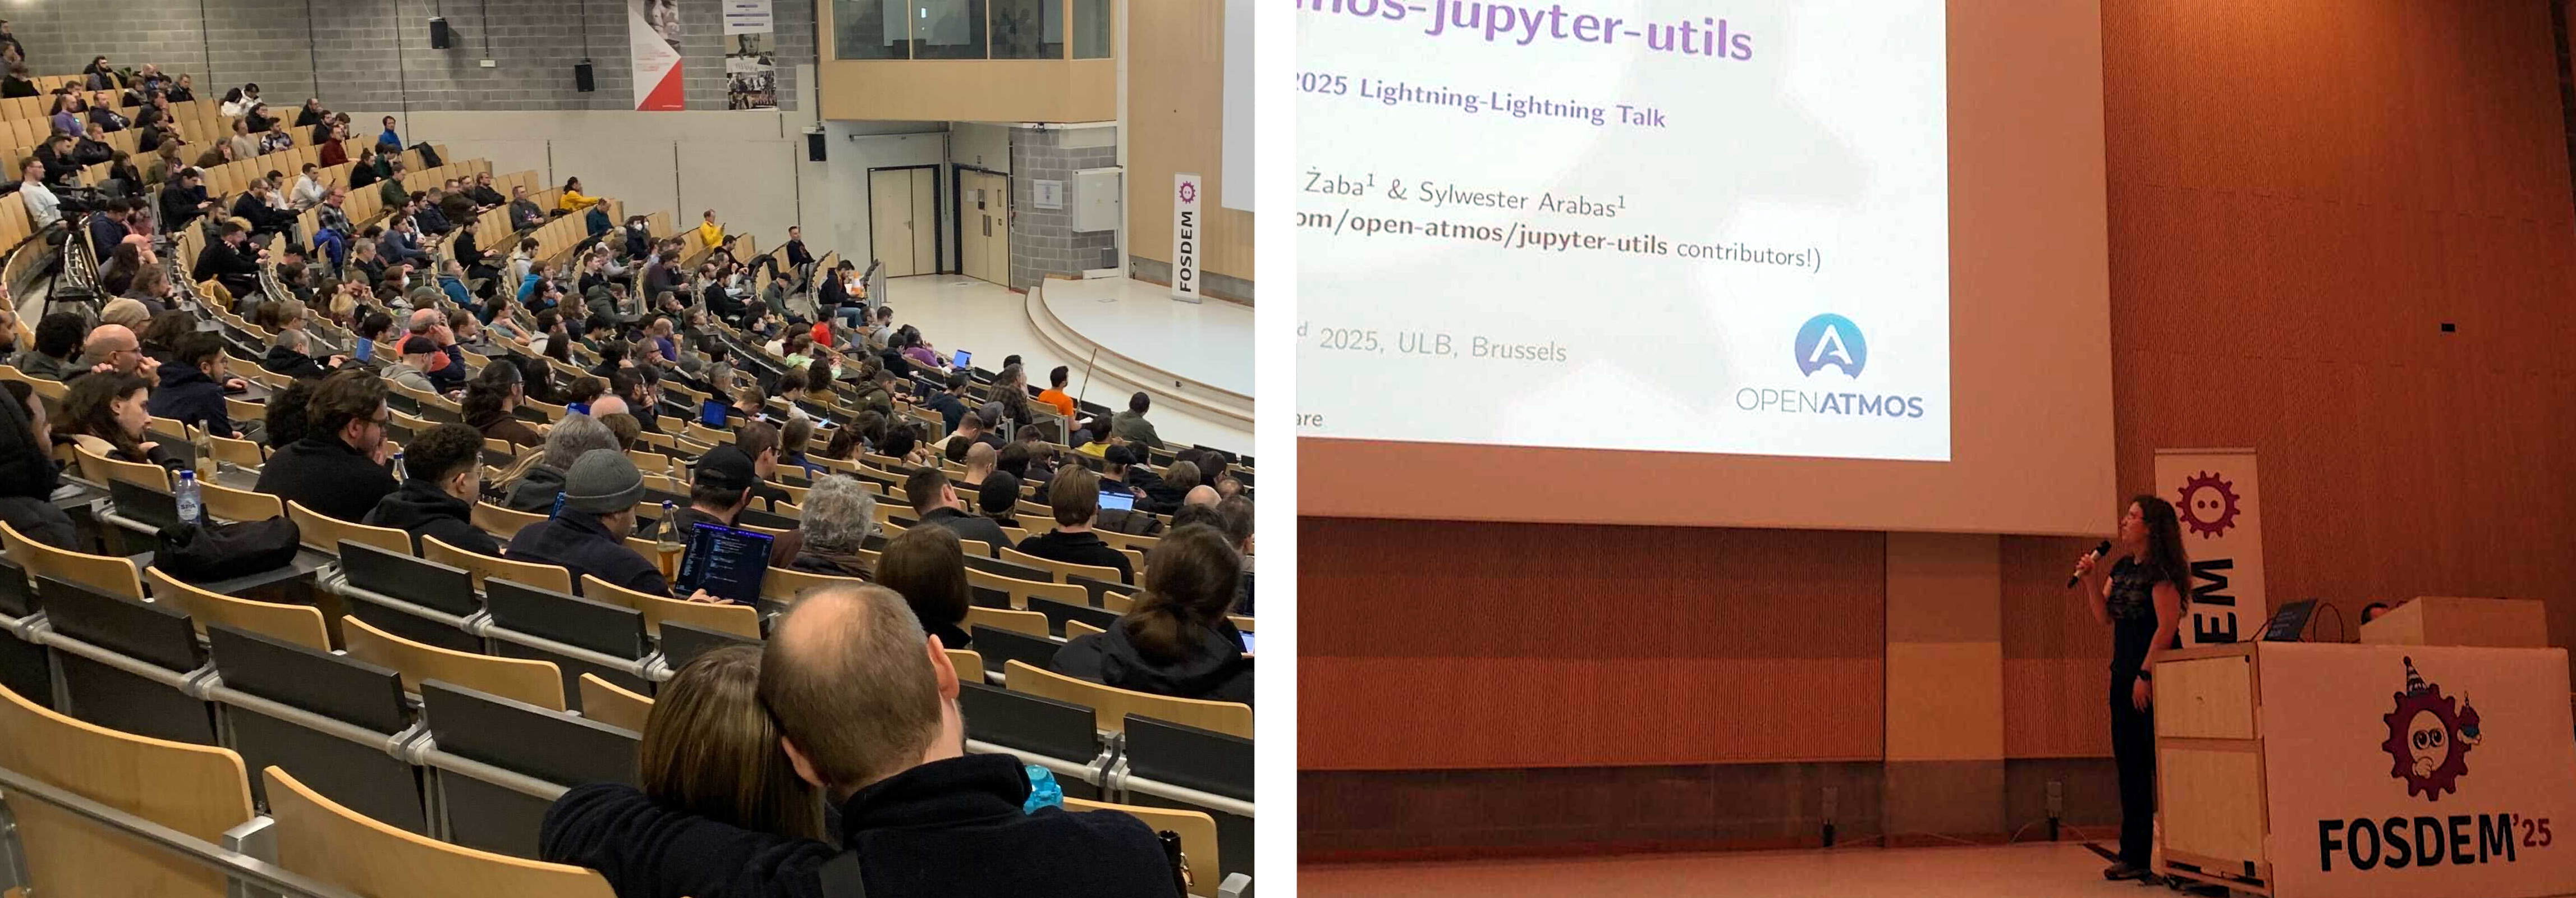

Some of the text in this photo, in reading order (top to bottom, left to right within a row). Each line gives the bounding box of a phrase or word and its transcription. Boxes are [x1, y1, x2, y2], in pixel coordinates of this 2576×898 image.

[1297, 72, 1666, 129] 025 Lightning-Lightning Talk
[1388, 178, 1408, 201] &
[1419, 181, 1529, 210] Sylwester
[1180, 211, 1193, 292] FOSDEM
[1297, 209, 1822, 274] om/open-atmos/jupyter-utils contributors!)
[1319, 327, 1385, 356] 2025,
[1399, 331, 1458, 359] ULB,
[1472, 336, 1567, 363] Brussels
[1736, 387, 1924, 419] OPENATMOS
